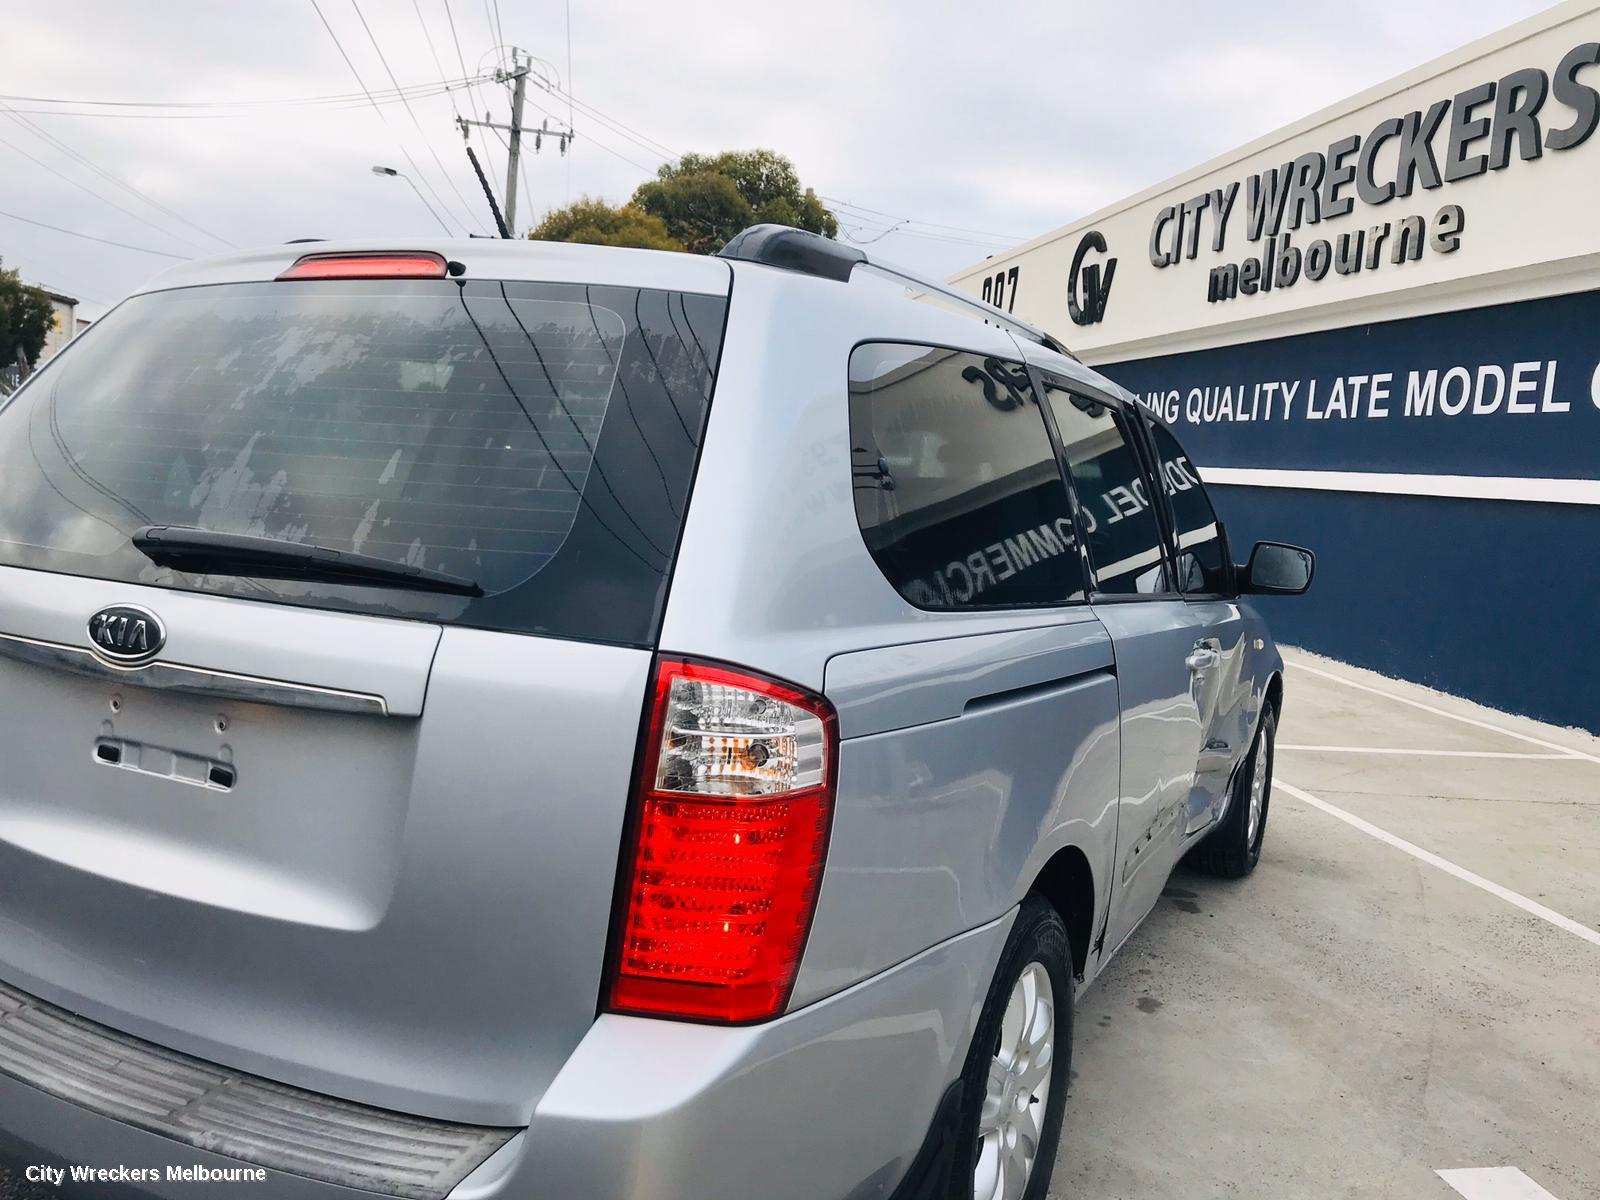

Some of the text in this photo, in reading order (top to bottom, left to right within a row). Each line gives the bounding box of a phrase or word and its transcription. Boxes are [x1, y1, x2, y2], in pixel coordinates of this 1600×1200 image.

[1149, 42, 1600, 268] CITY WRECKERS
[1207, 204, 1465, 303] melbourne
[1186, 381, 1300, 425] QUALITY
[1306, 372, 1393, 420] LATE
[1404, 360, 1571, 418] MODEL
[97, 614, 149, 650] KIA
